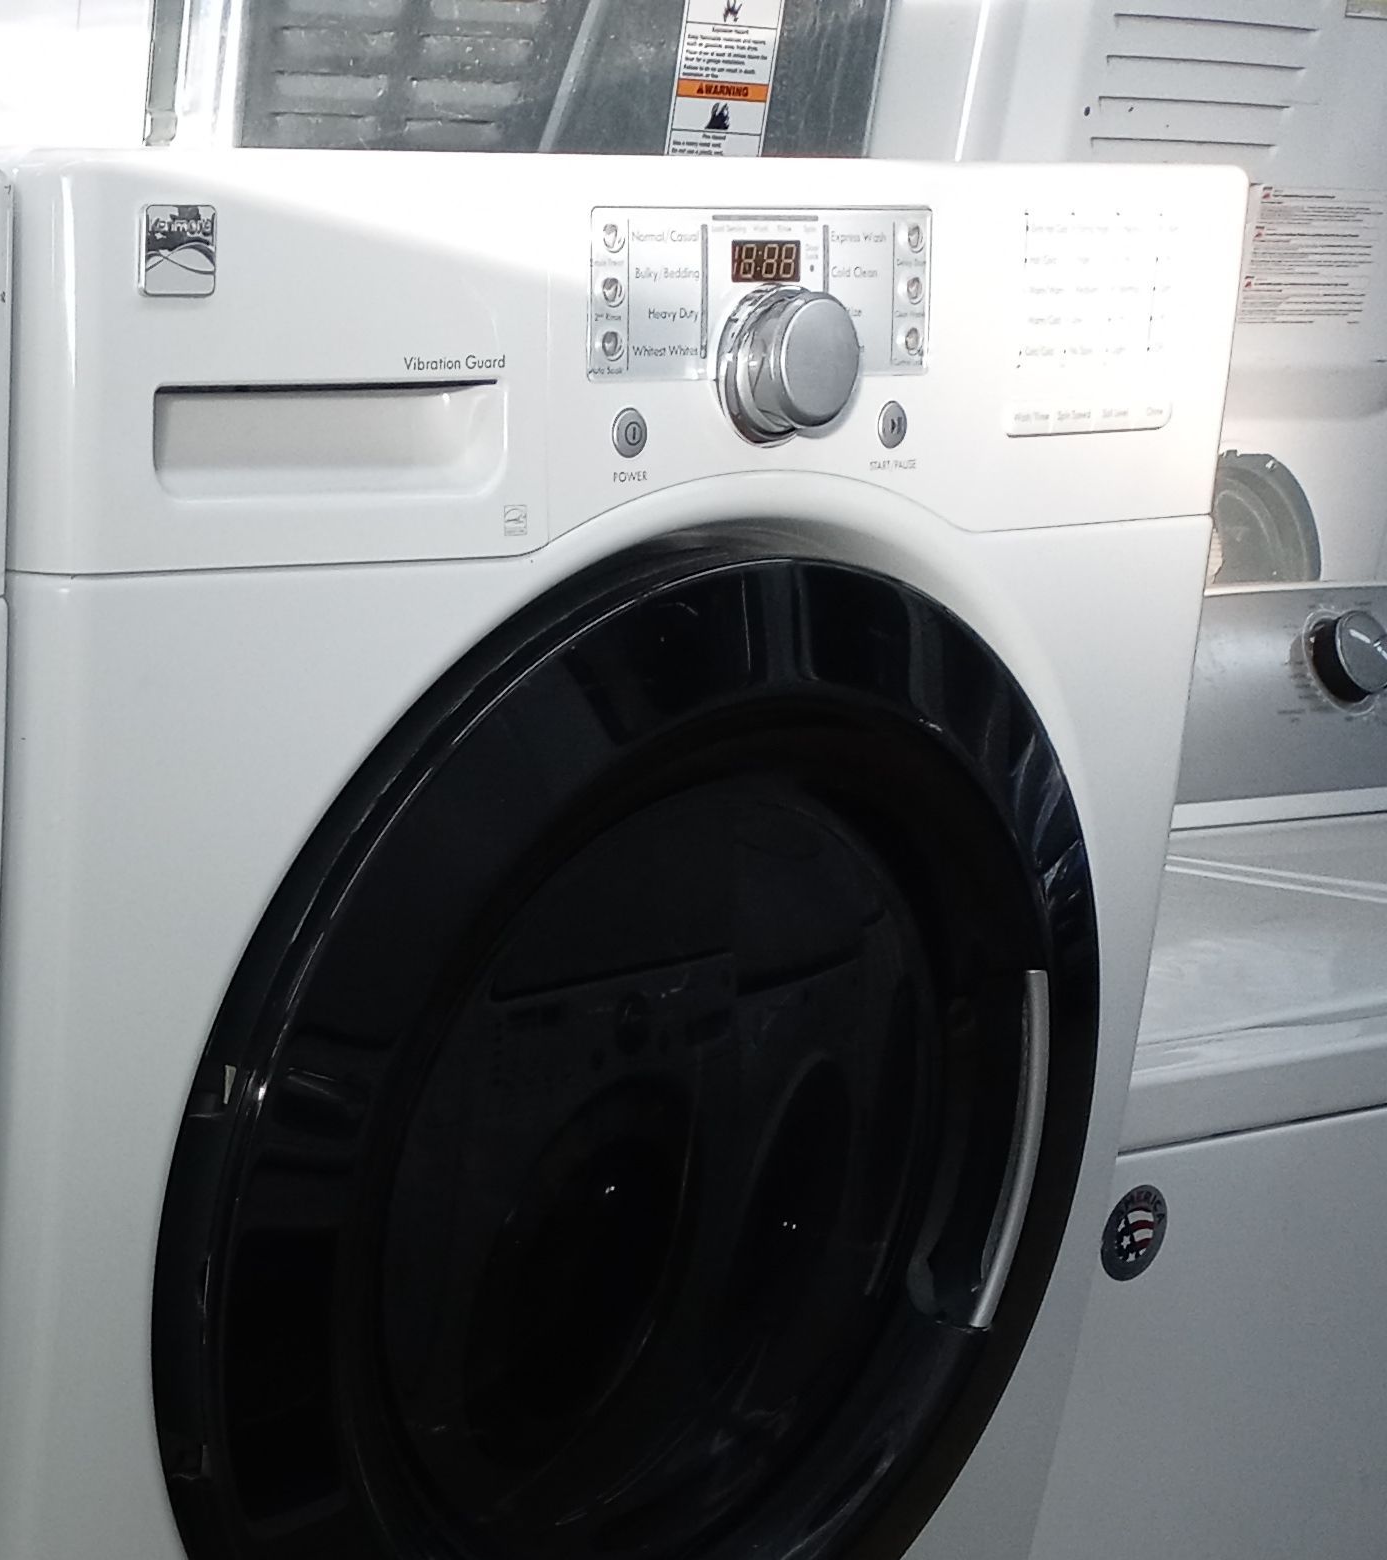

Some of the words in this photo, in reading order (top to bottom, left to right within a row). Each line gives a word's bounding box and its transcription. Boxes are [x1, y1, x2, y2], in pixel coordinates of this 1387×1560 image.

[705, 84, 749, 97] WARNING
[648, 308, 677, 322] Heavy
[404, 356, 461, 371] Vibration
[465, 354, 506, 369] Guard
[613, 470, 648, 483] POWER
